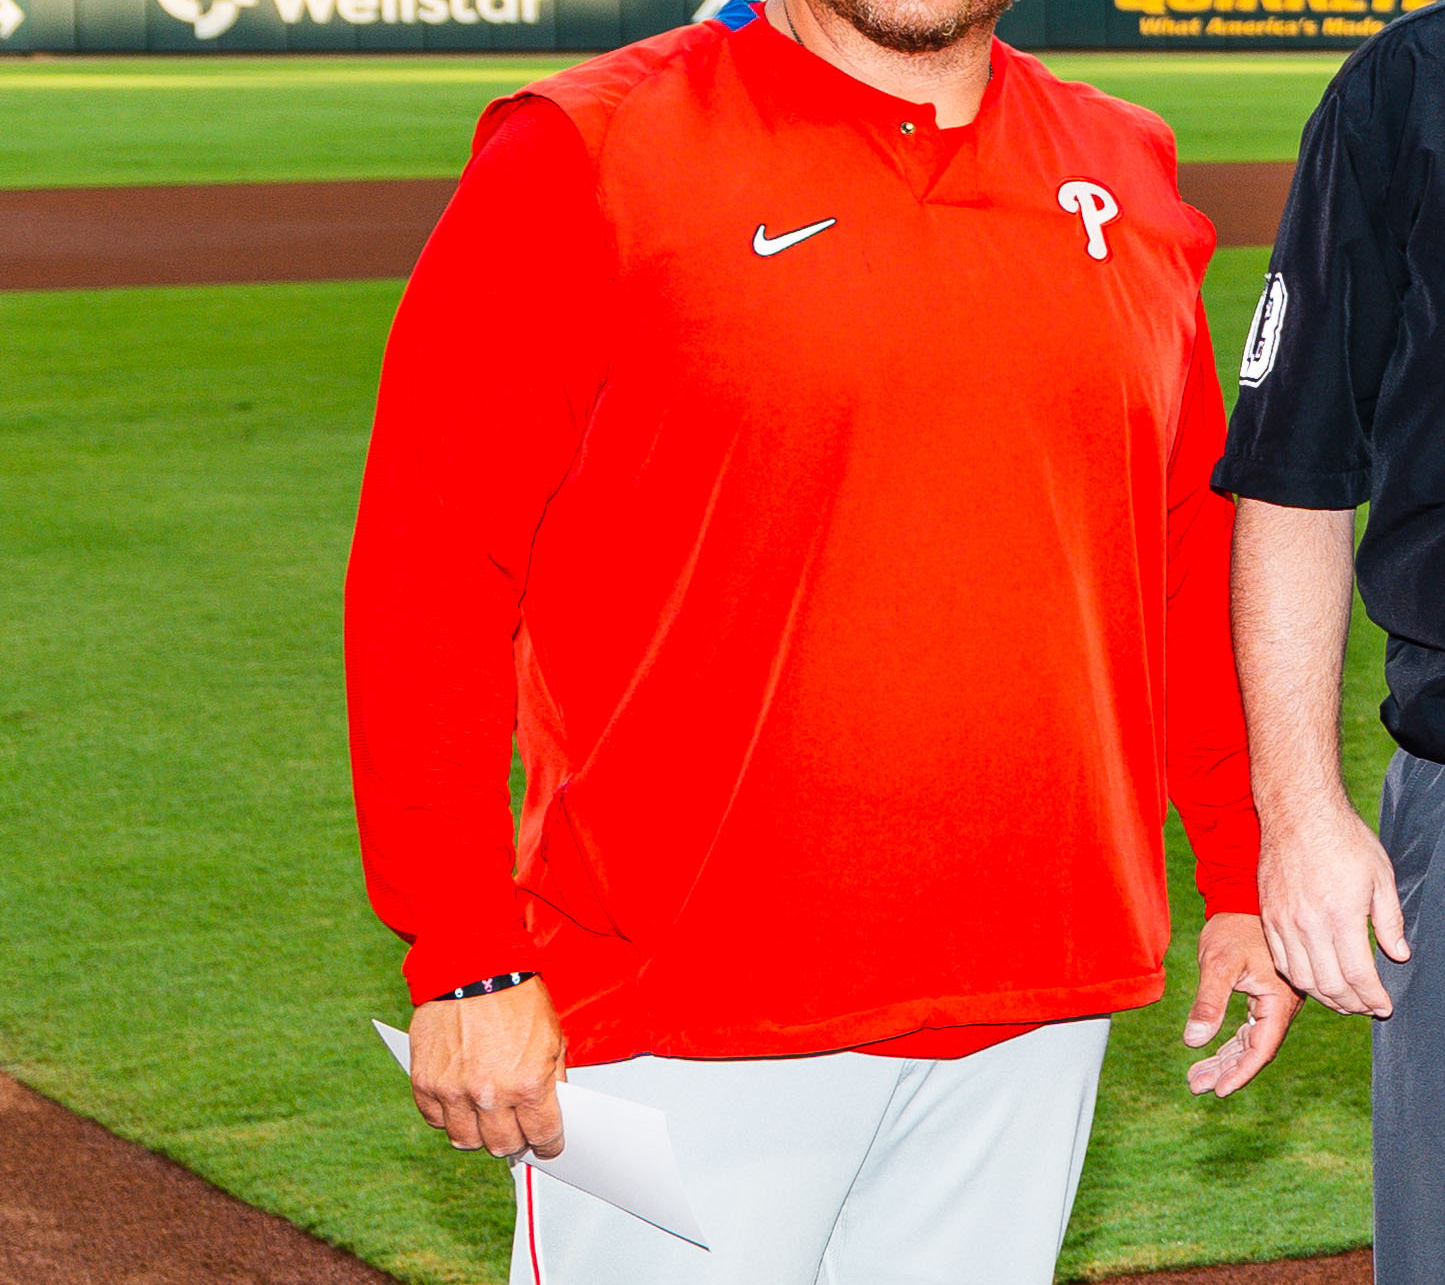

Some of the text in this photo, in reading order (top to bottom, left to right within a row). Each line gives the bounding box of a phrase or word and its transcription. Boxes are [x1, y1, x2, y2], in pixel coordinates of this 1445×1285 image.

[1138, 16, 1201, 37] What
[1205, 16, 1319, 37] America's
[1058, 176, 1123, 262] P
